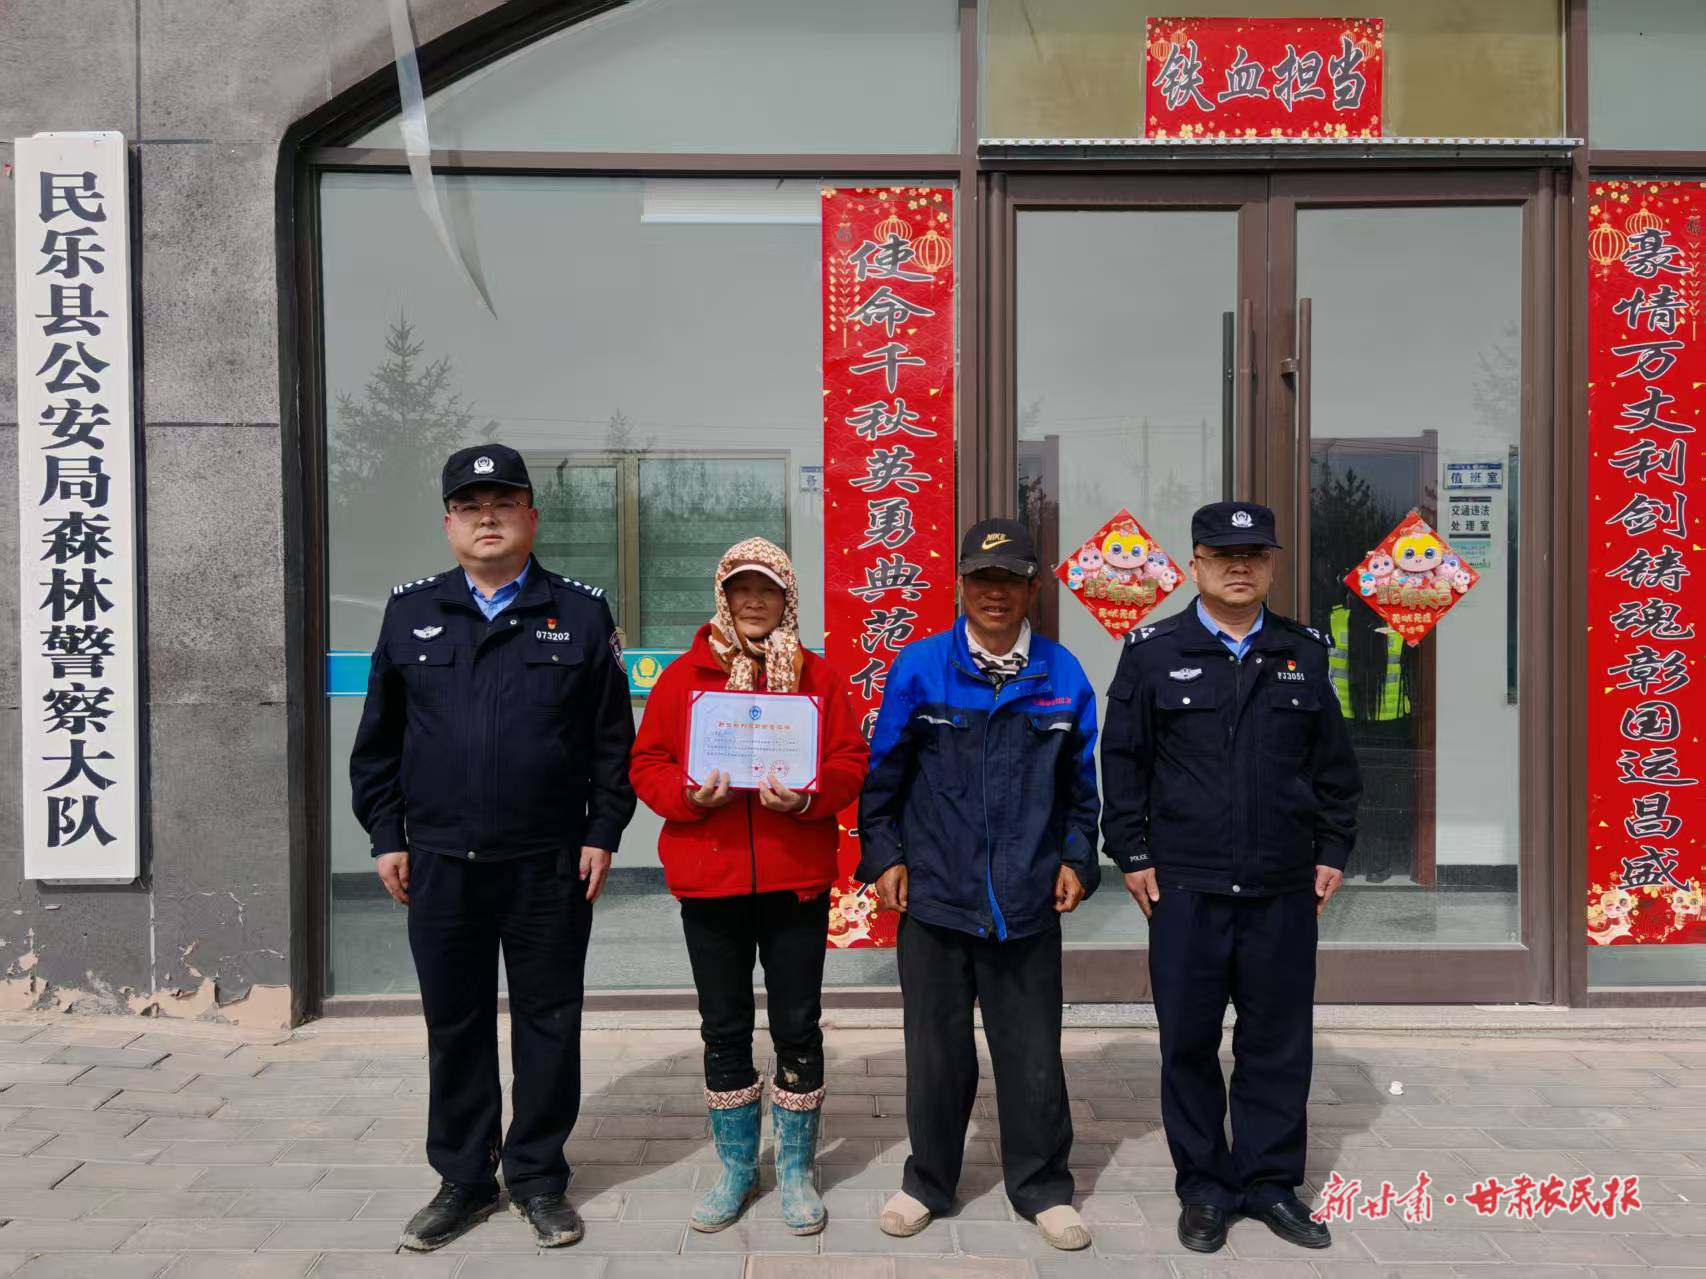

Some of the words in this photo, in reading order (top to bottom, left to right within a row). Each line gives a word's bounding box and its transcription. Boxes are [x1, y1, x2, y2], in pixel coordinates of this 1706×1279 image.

[1153, 35, 1367, 112] 铁血担当
[1449, 471, 1498, 484] 值班室
[35, 170, 117, 848] 民乐县公安局森林警察大队
[1451, 504, 1490, 517] 交通违法
[1451, 520, 1490, 532] 处理室
[986, 533, 1006, 541] NIKE
[1605, 227, 1698, 893] 豪情万丈利剑铸魂彰国运昌盛
[536, 630, 570, 641] 073202
[1129, 853, 1149, 863] POLICE
